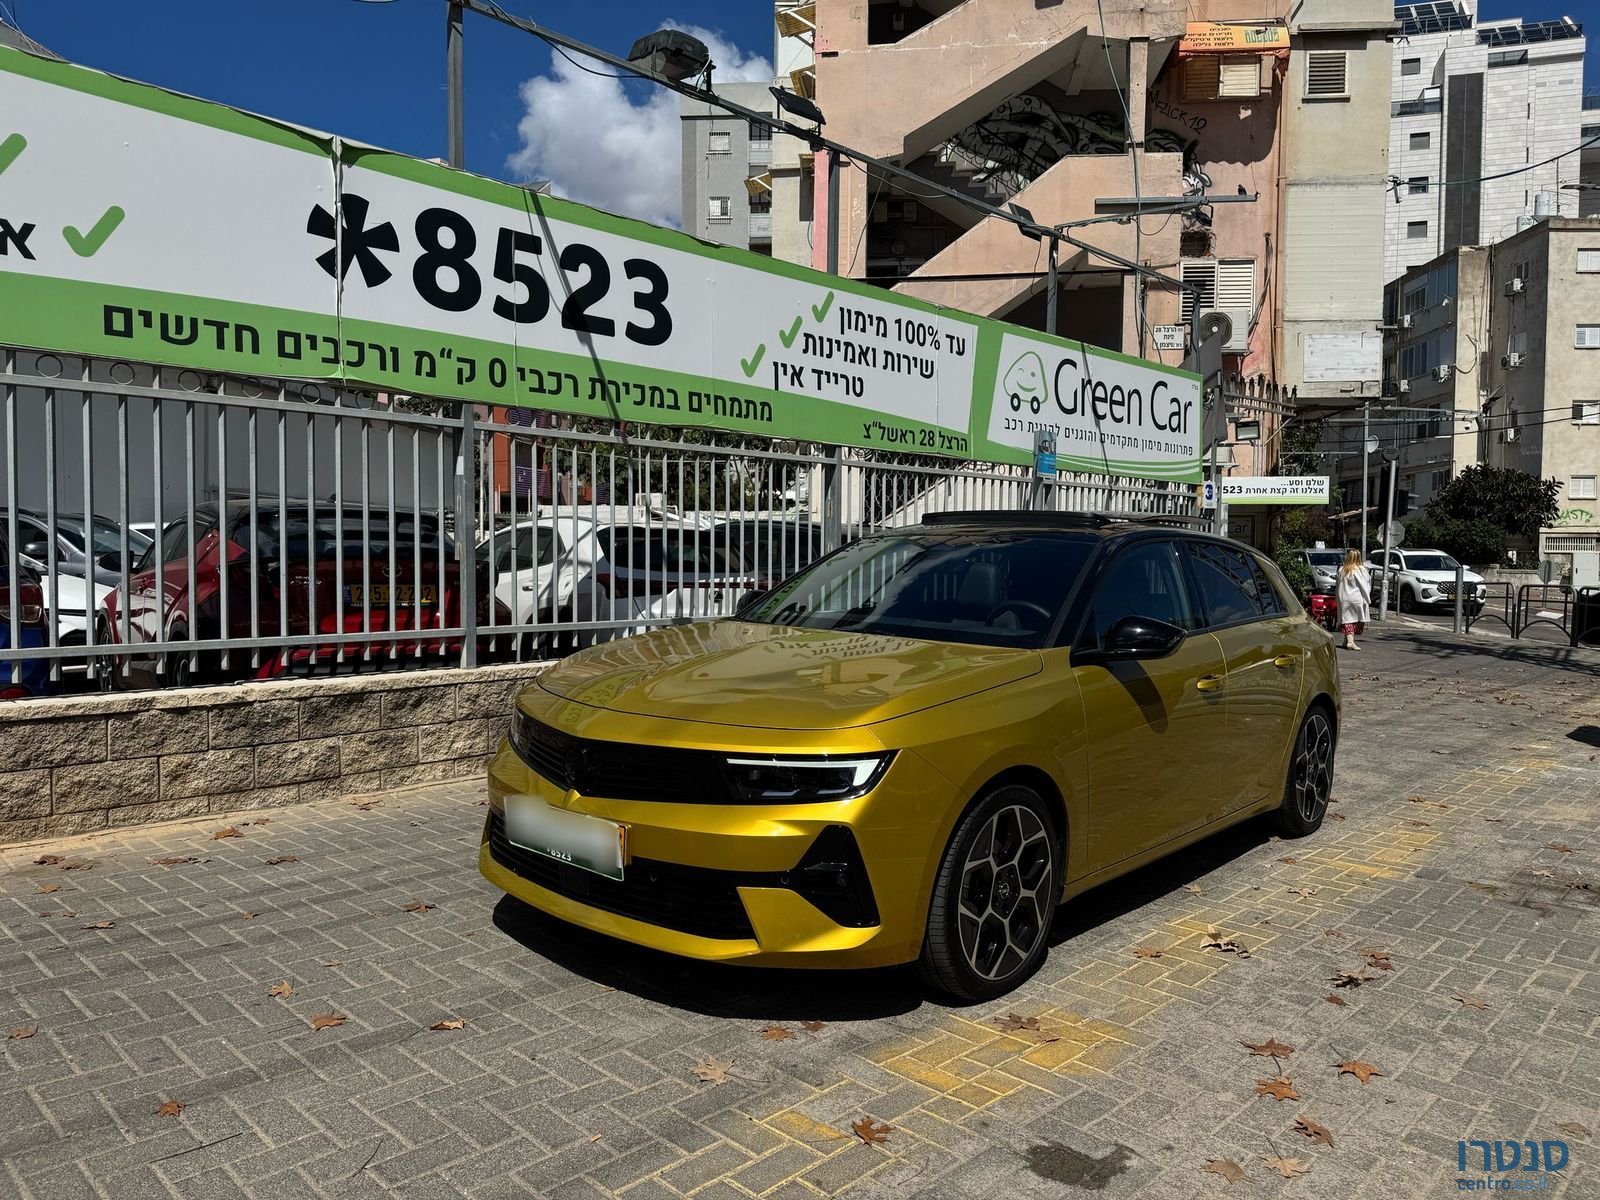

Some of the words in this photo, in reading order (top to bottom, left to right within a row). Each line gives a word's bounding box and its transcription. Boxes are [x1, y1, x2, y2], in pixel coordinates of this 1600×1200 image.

[103, 304, 260, 355] חדשים
[839, 306, 888, 338] מימון
[894, 318, 941, 351] 100%
[278, 330, 400, 374] ורכבים
[802, 332, 878, 368] ואמינות
[945, 333, 966, 356] עד
[488, 358, 507, 388] 0
[773, 361, 804, 391] אין
[882, 350, 934, 379] שירות
[516, 366, 579, 398] רכבי
[588, 376, 681, 411] במכירת
[811, 368, 864, 398] טרייד
[1054, 358, 1143, 427] Green
[1150, 380, 1193, 434] Car
[688, 391, 773, 422] מתמחים
[920, 429, 935, 447] 28
[1004, 418, 1024, 432] רכב
[1064, 426, 1098, 442] והוגנים
[938, 430, 968, 452] הרצל
[1100, 432, 1139, 450] מתקדמים
[1141, 438, 1162, 452] מימון
[1164, 442, 1194, 456] פתרונות
[1270, 487, 1287, 495] קצת
[1306, 478, 1324, 486] שלם
